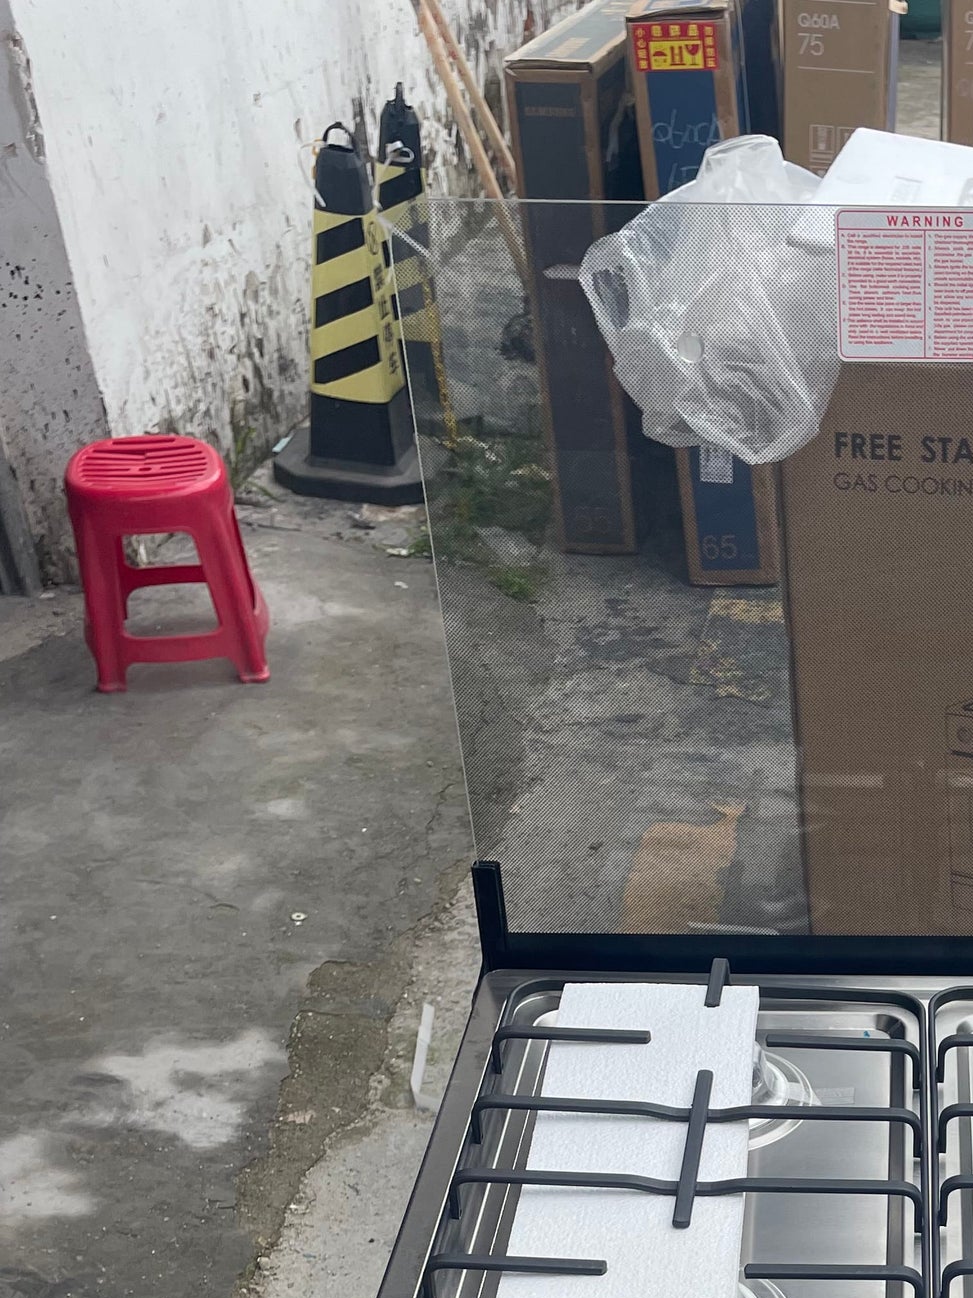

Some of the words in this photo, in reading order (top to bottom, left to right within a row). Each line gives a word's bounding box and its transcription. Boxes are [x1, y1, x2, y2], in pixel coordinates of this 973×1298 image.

[798, 13, 841, 29] Q60A
[797, 33, 825, 55] 75
[886, 215, 964, 228] WARNING
[834, 431, 903, 462] FREE
[833, 472, 877, 493] GAS
[702, 535, 739, 560] 65
